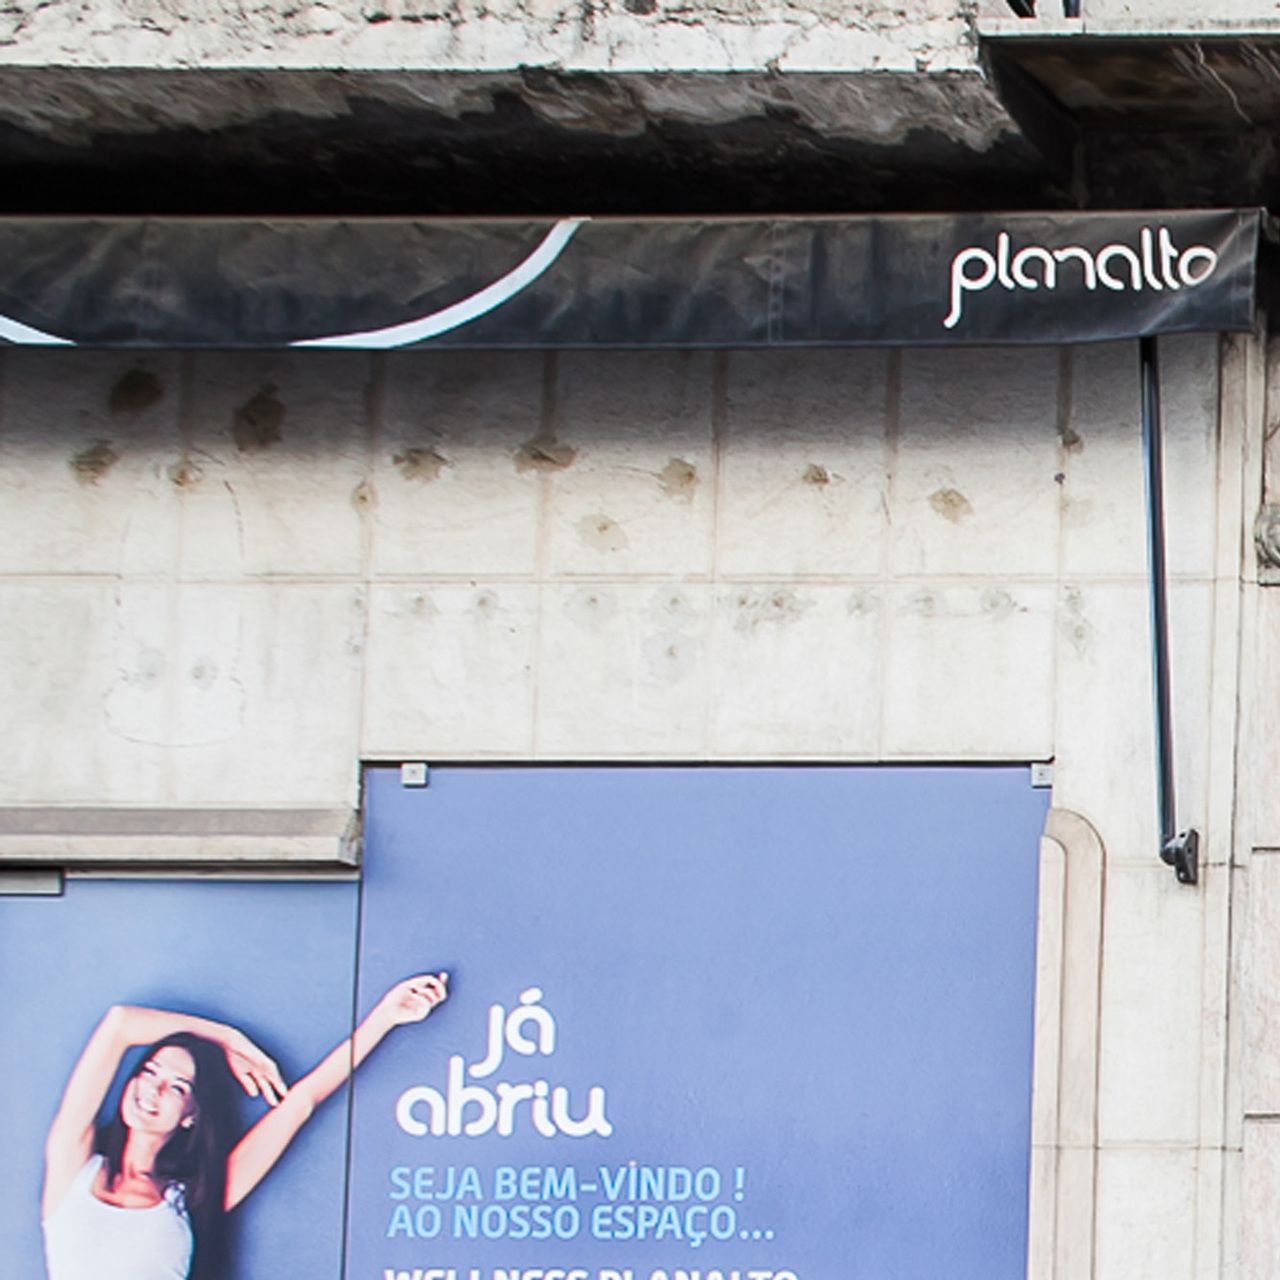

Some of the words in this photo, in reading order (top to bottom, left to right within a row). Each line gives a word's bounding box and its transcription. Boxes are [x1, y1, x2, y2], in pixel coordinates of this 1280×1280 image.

[943, 226, 1217, 328] planalto
[468, 987, 555, 1078] já
[395, 1054, 612, 1137] abriu
[389, 1166, 483, 1201] SEJA
[734, 1166, 745, 1201] !
[387, 1204, 441, 1238] AO
[453, 1204, 579, 1239] NOSSO
[592, 1205, 774, 1248] ESPAÇO...
